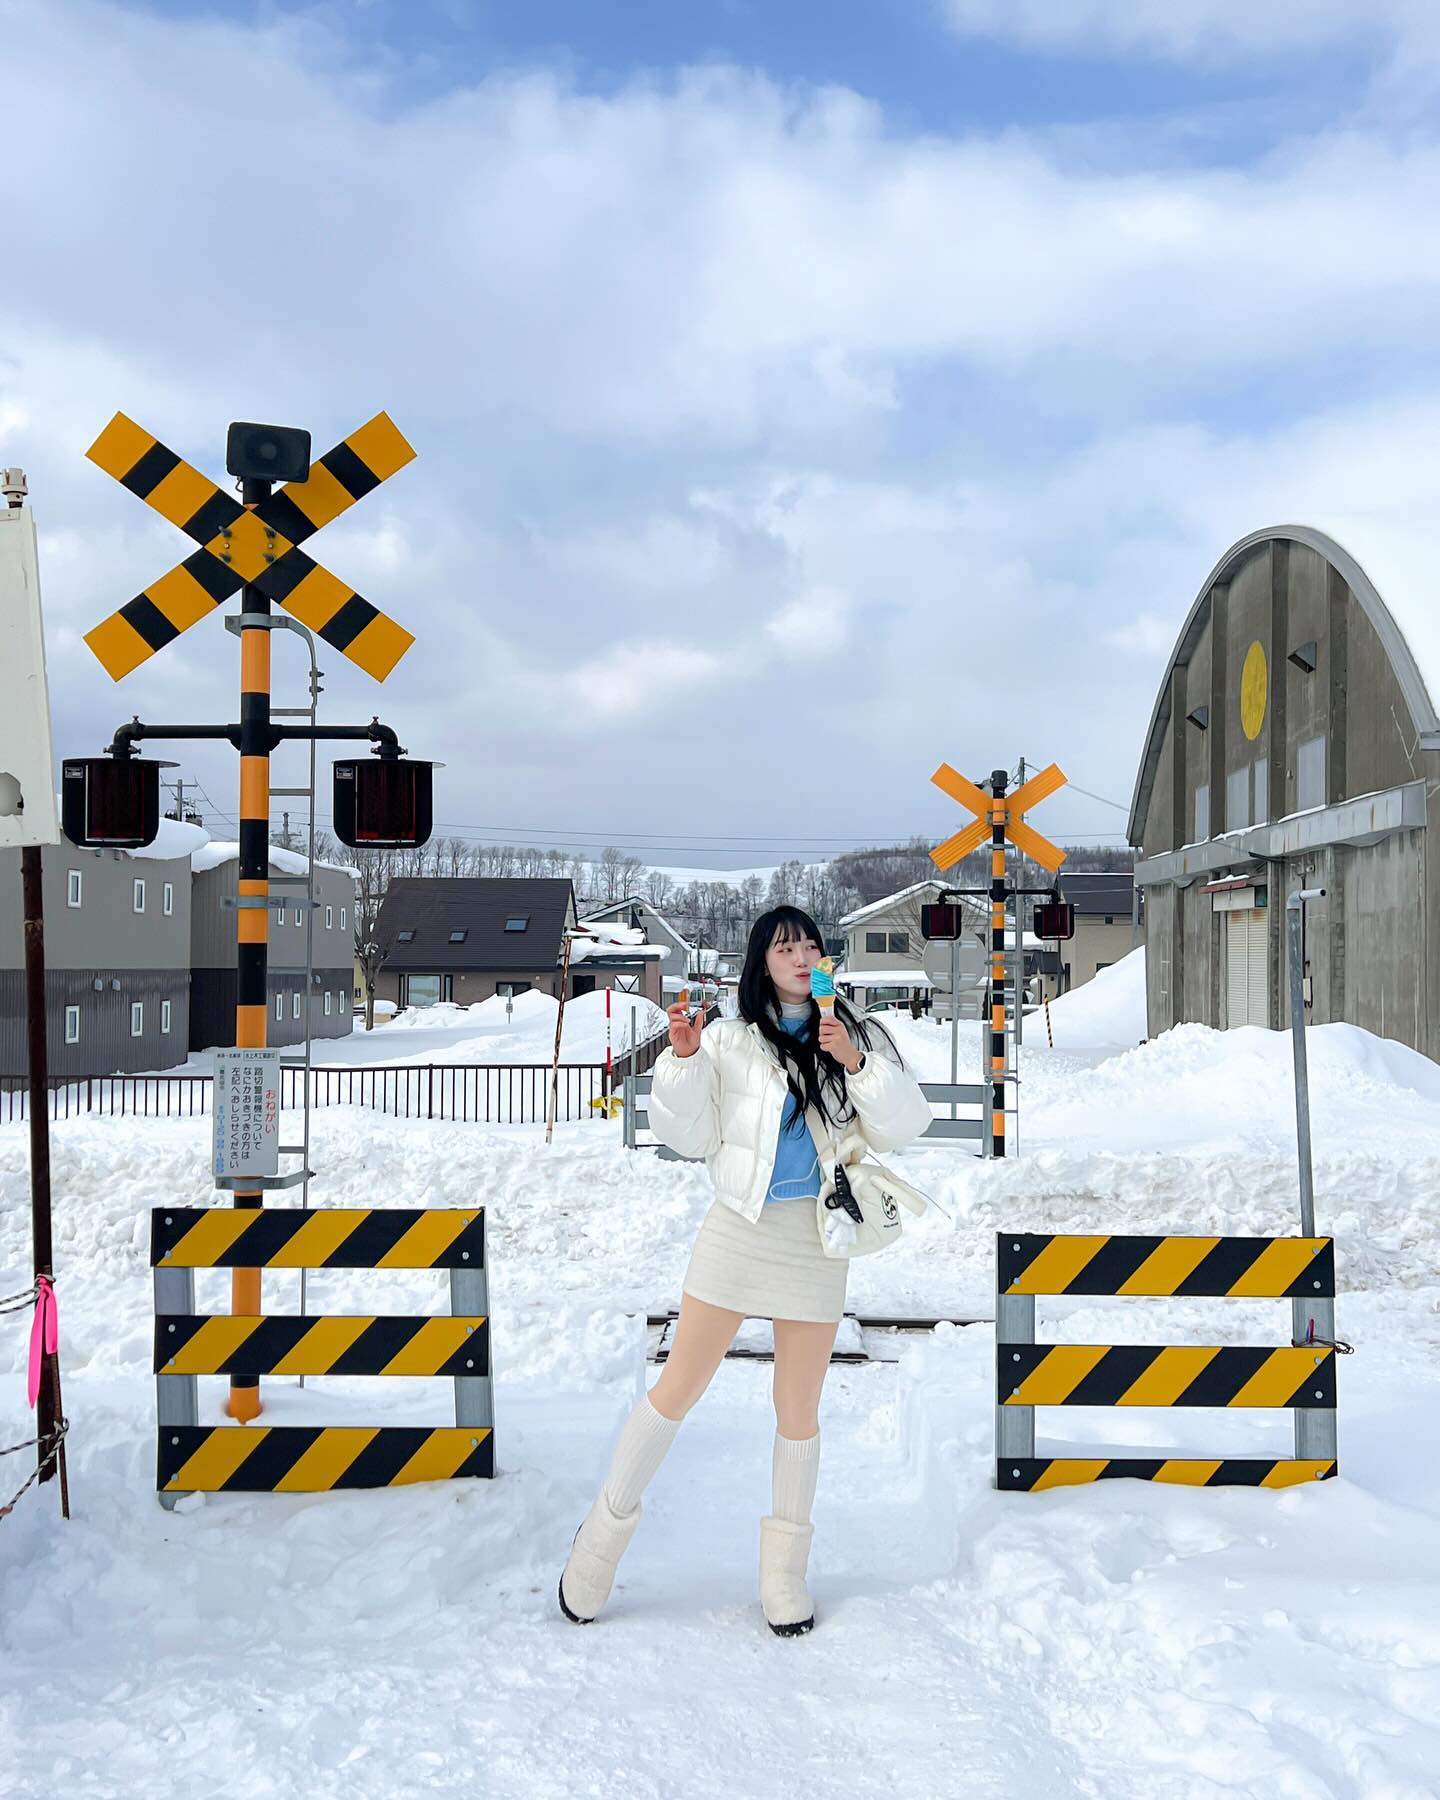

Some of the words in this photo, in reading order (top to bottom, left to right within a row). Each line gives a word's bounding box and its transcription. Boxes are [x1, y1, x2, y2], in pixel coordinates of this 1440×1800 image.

[230, 1067, 240, 1168] 左記へおしらせください
[265, 1089, 276, 1133] おねがい
